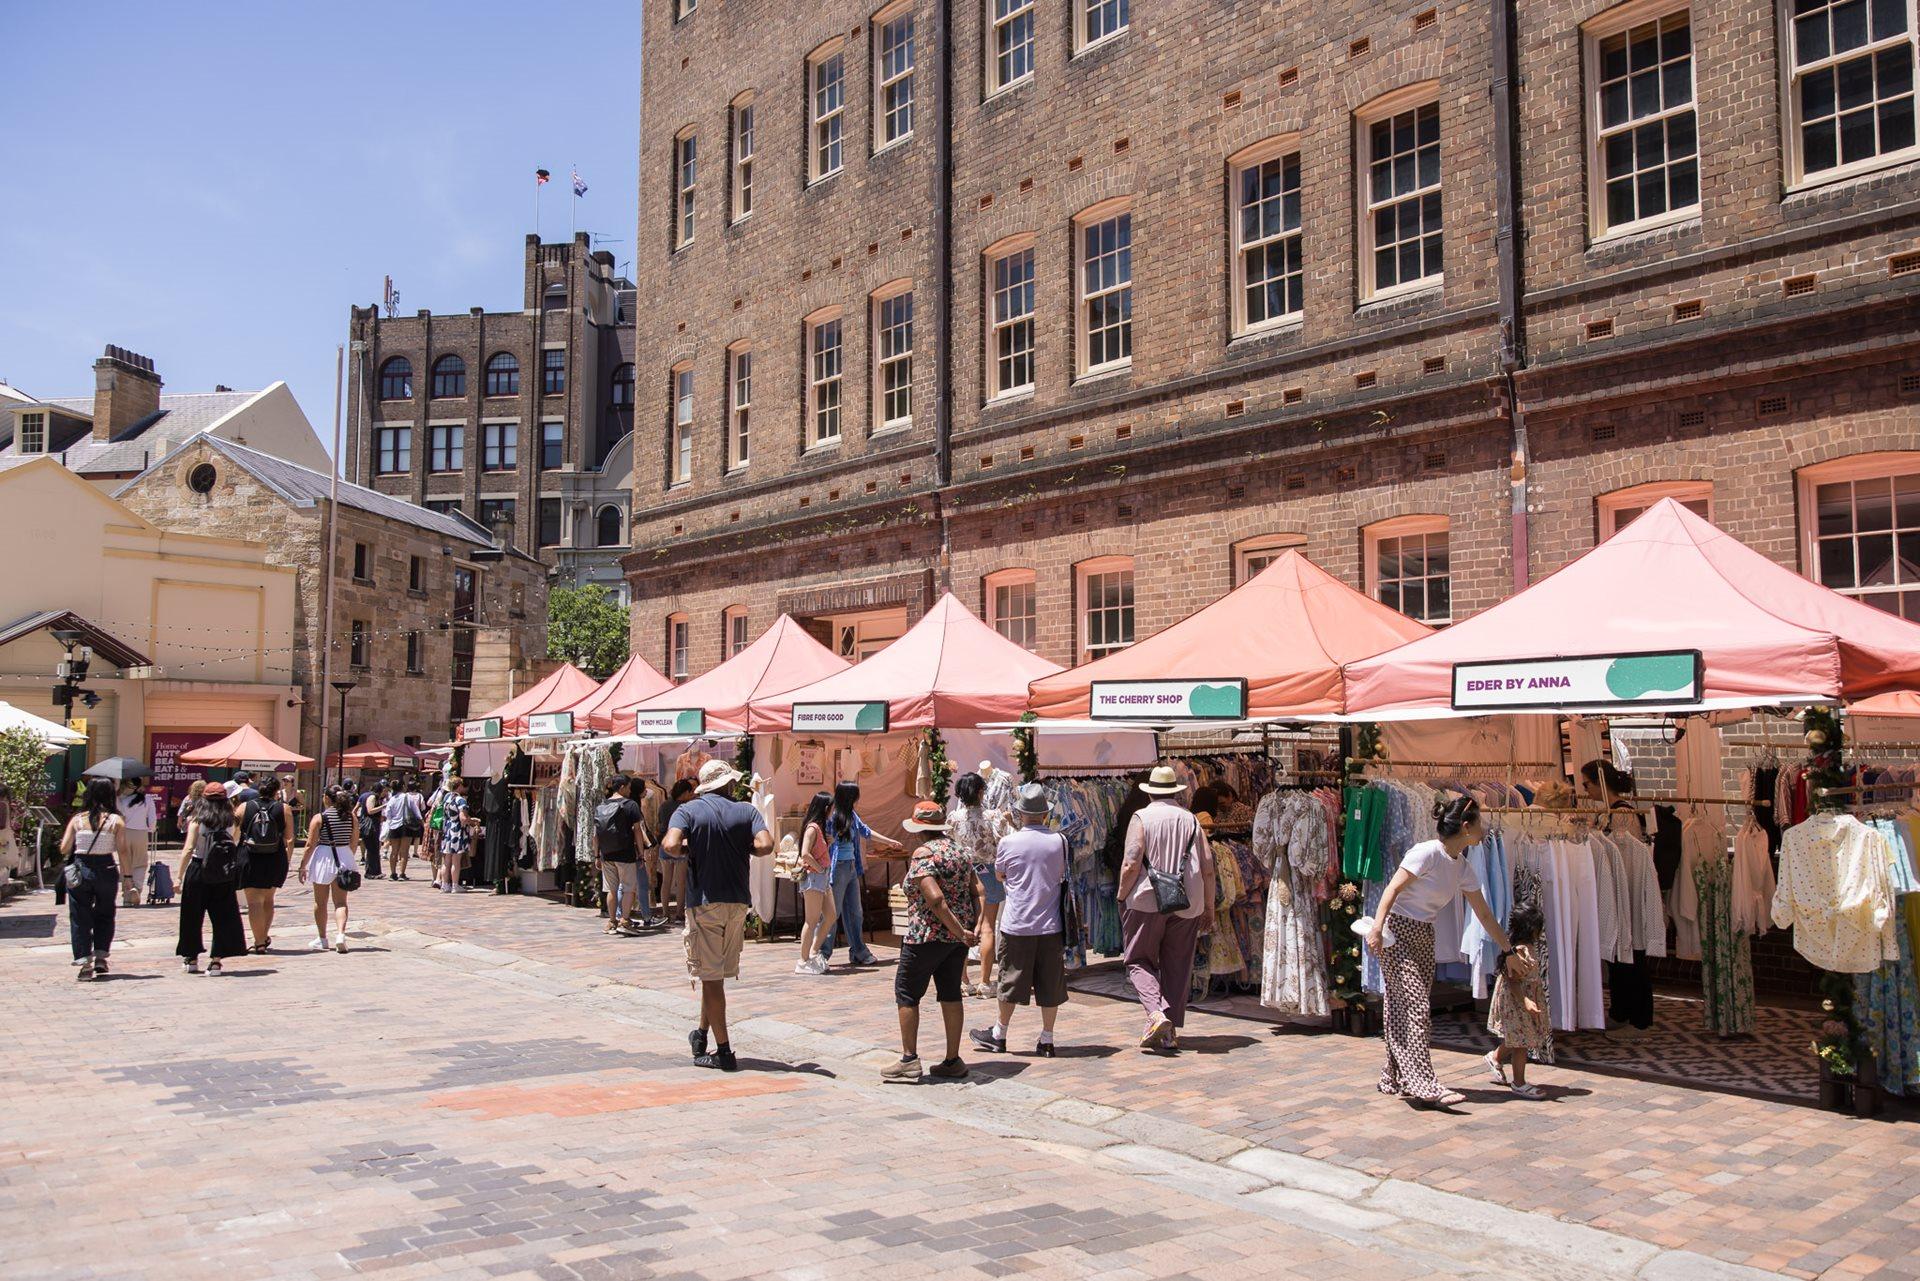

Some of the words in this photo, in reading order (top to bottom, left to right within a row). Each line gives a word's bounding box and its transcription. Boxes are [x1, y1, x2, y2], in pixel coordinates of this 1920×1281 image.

[1467, 680, 1503, 691] EDER
[1506, 679, 1525, 690] BY
[1528, 676, 1571, 689] ANNA
[1100, 695, 1117, 704] THE
[1119, 695, 1155, 704] CHERRY
[1157, 694, 1183, 704] SHOP
[797, 713, 814, 721] FIBRE
[814, 713, 826, 721] FOR
[827, 713, 845, 721] GOOD
[156, 742, 179, 750] Home
[180, 742, 189, 750] of
